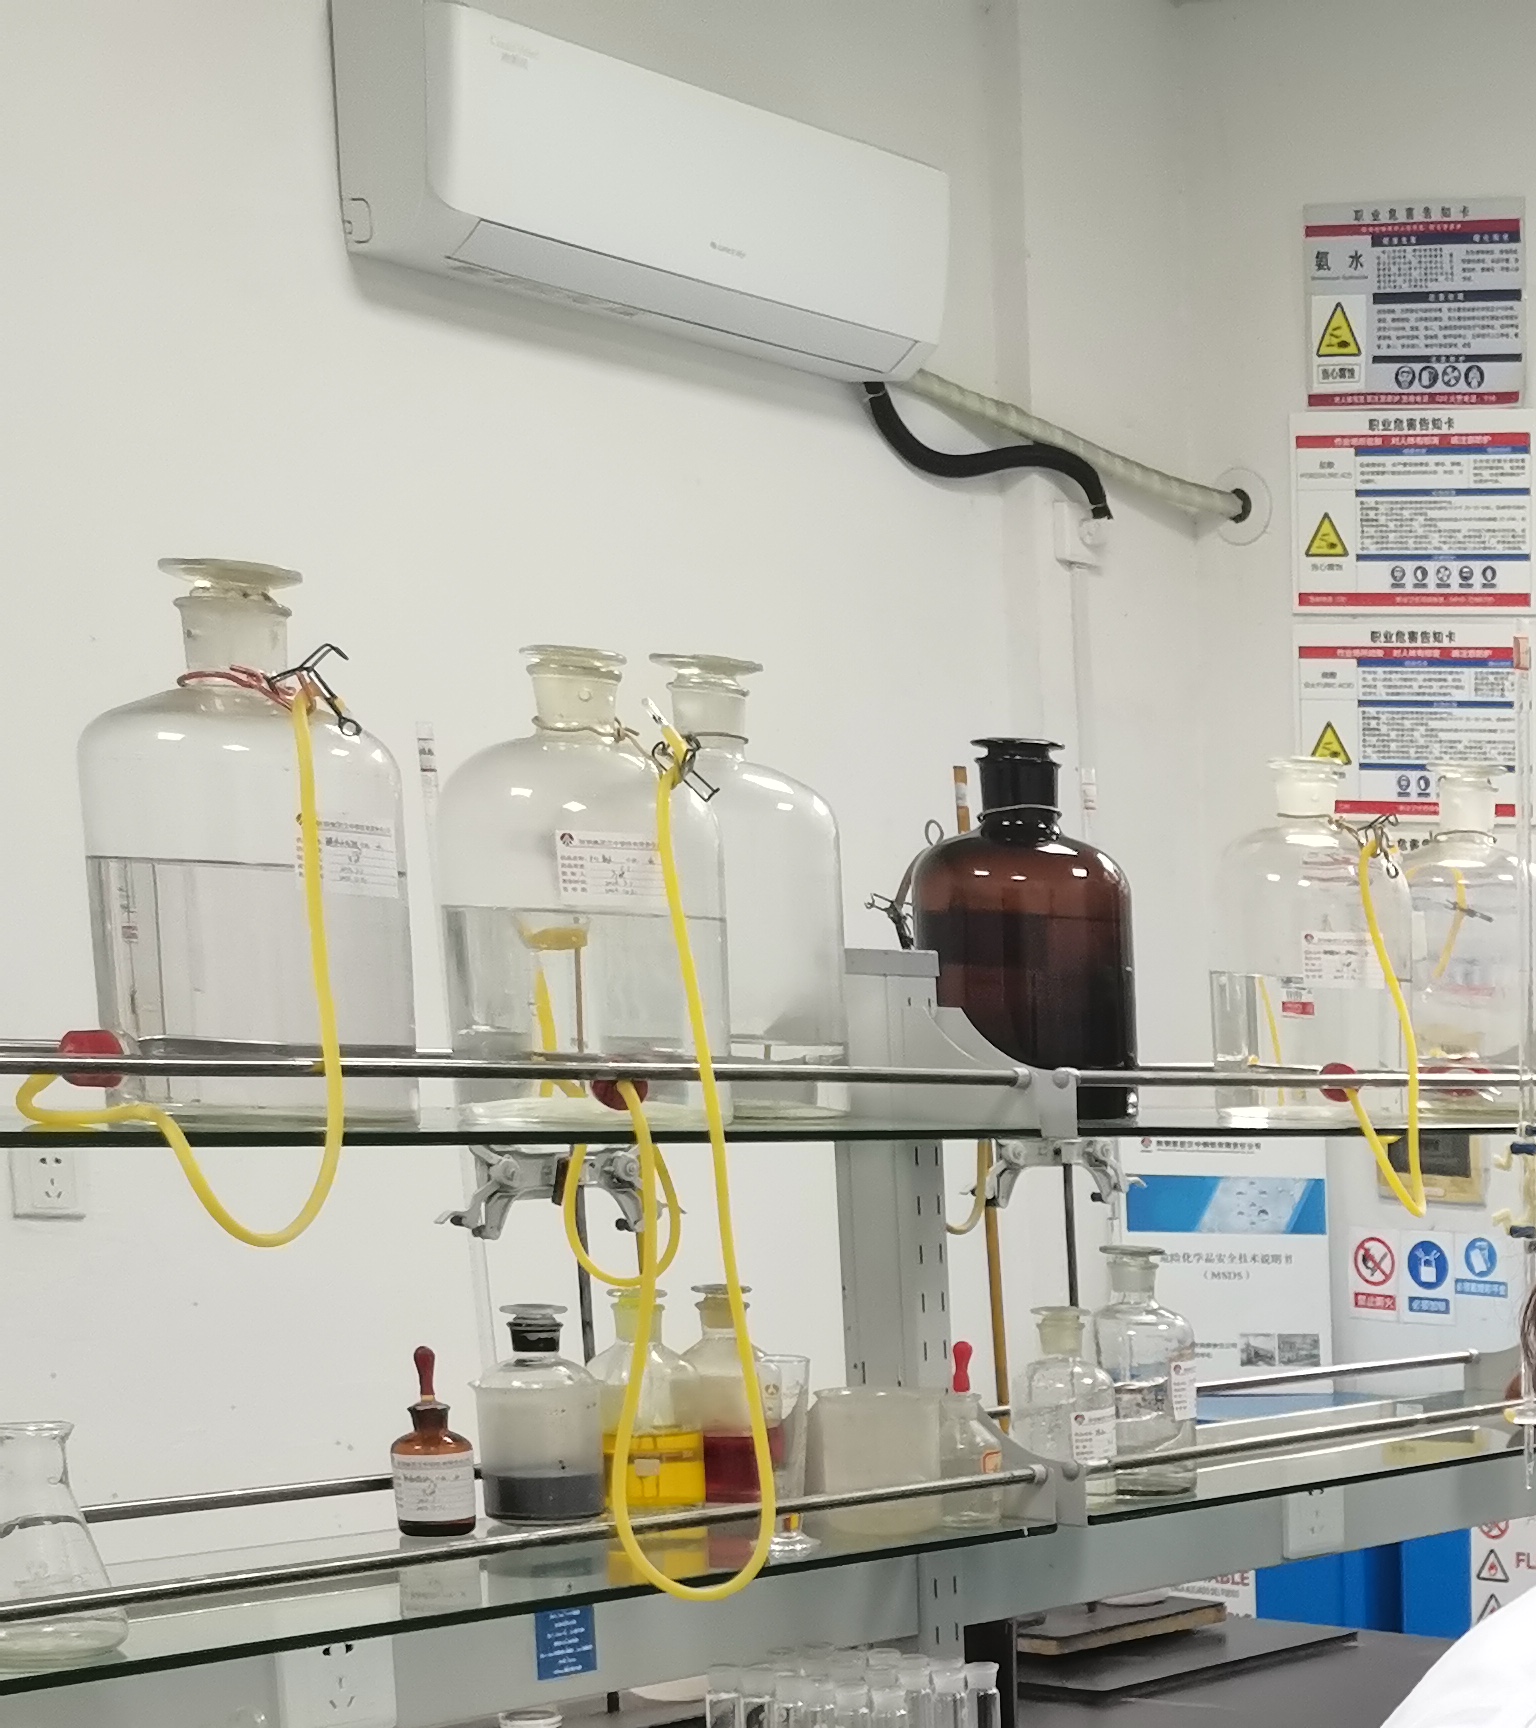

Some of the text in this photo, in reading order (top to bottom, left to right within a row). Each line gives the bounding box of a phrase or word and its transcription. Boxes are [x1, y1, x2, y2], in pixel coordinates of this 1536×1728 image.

[1353, 205, 1470, 221] 职业危害告知卡
[1315, 250, 1364, 271] 氨水
[1368, 417, 1455, 431] 职业危害告知卡
[1370, 630, 1456, 644] 职业危害告知卡
